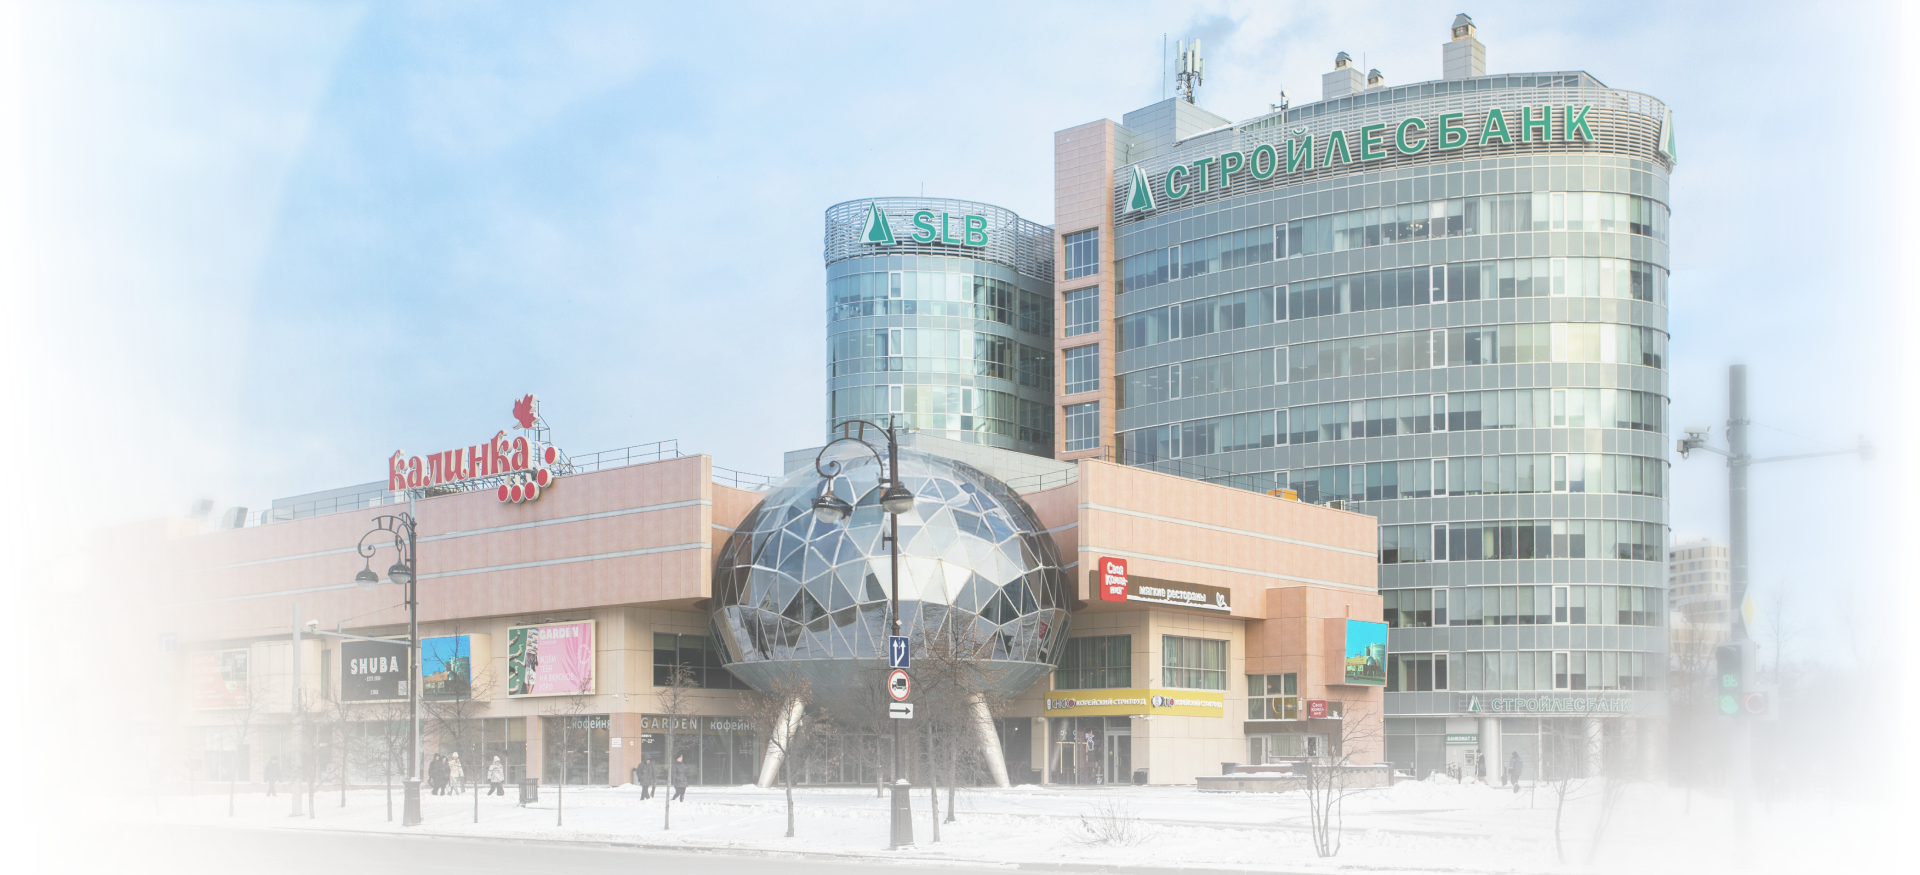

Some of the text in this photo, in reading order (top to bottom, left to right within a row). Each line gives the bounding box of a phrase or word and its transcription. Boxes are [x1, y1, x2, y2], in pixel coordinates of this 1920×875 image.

[1165, 103, 1594, 199] СТРОЙЛЕСБАНК
[911, 210, 989, 247] SLB
[1107, 562, 1124, 575] Своя
[1139, 585, 1206, 604] мягкие рестораны
[350, 656, 399, 675] SHUBA
[540, 665, 553, 673] ТЕБЯ
[539, 673, 574, 682] НА ВКУСНОЕ
[539, 683, 553, 691] УТРО
[1076, 697, 1113, 707] КОРЕЙСКИЙ
[1113, 697, 1147, 706] СТРИТФУД
[1492, 695, 1632, 712] СТРОЙЛЕСБАНК
[641, 716, 757, 733] GARDEN кофейня
